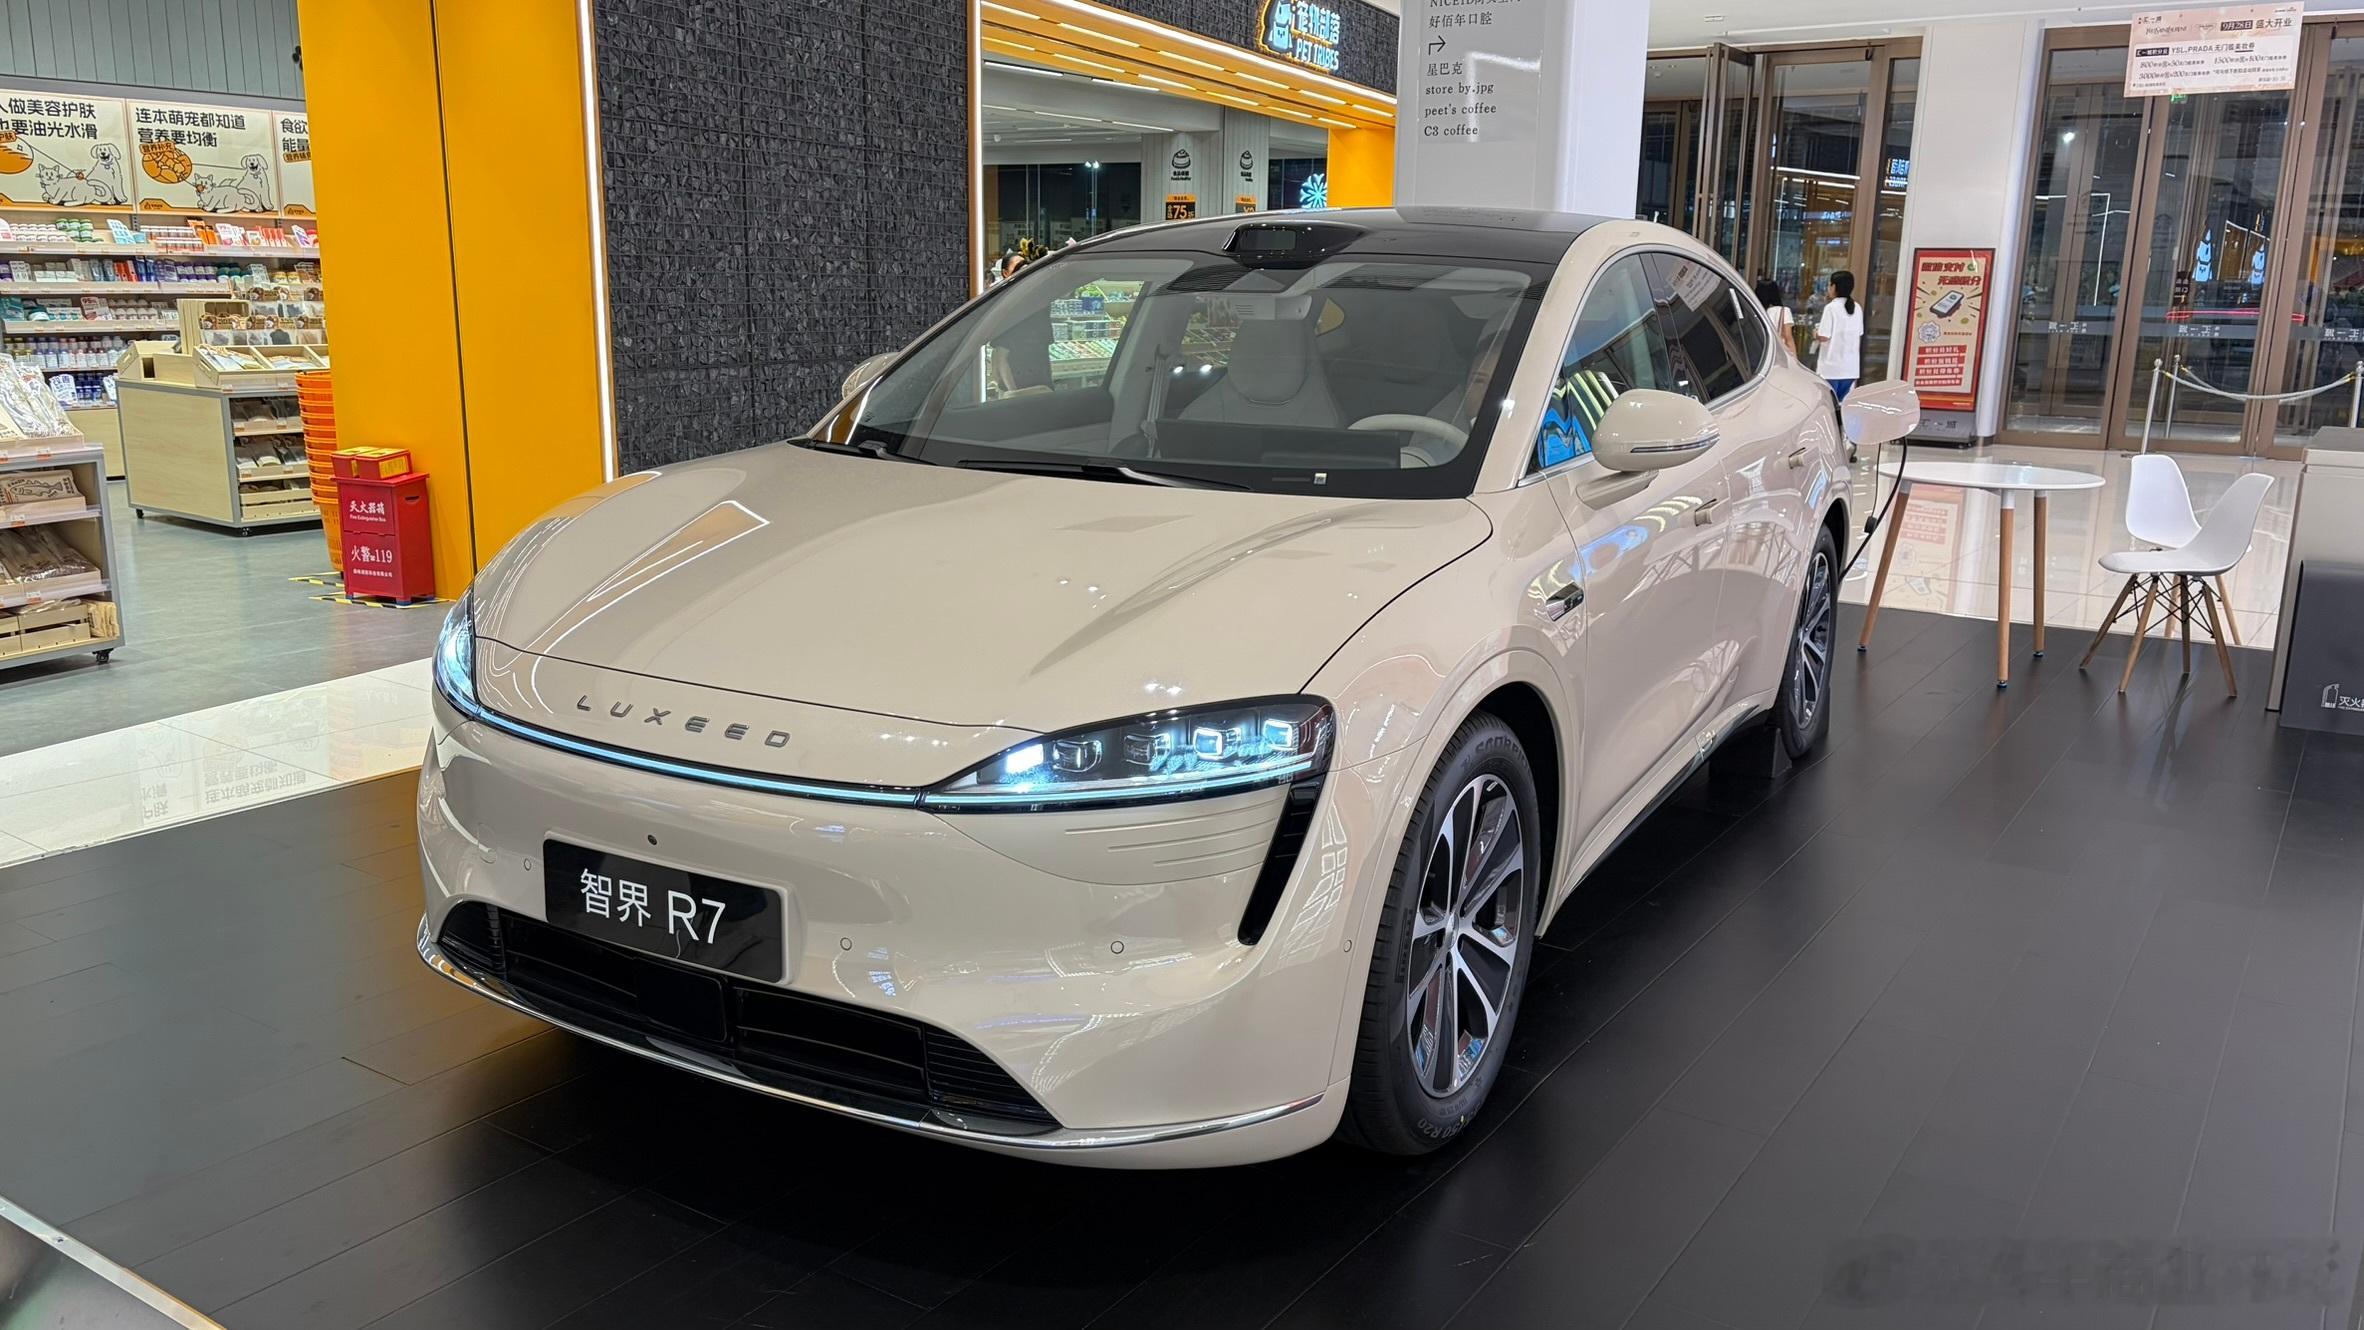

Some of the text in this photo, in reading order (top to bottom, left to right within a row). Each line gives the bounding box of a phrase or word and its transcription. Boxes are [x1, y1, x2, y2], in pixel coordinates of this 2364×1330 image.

[1428, 12, 1493, 29] 好佰年口腔
[2255, 17, 2293, 29] 盛大开业
[1296, 38, 1339, 70] PET TRIBES
[1427, 62, 1463, 76] 星巴克
[1425, 82, 1495, 95] store by.jpg
[1424, 103, 1497, 116] peet's coffee
[136, 108, 246, 130] 连本萌宠都知道
[280, 118, 308, 134] 食欲
[138, 128, 218, 147] 营养要均衡
[1424, 124, 1478, 137] C3 coffee
[1173, 205, 1187, 219] 75
[2339, 696, 2364, 708] 灭火
[577, 695, 791, 748] LUXEED
[580, 868, 726, 944] 智界 R7
